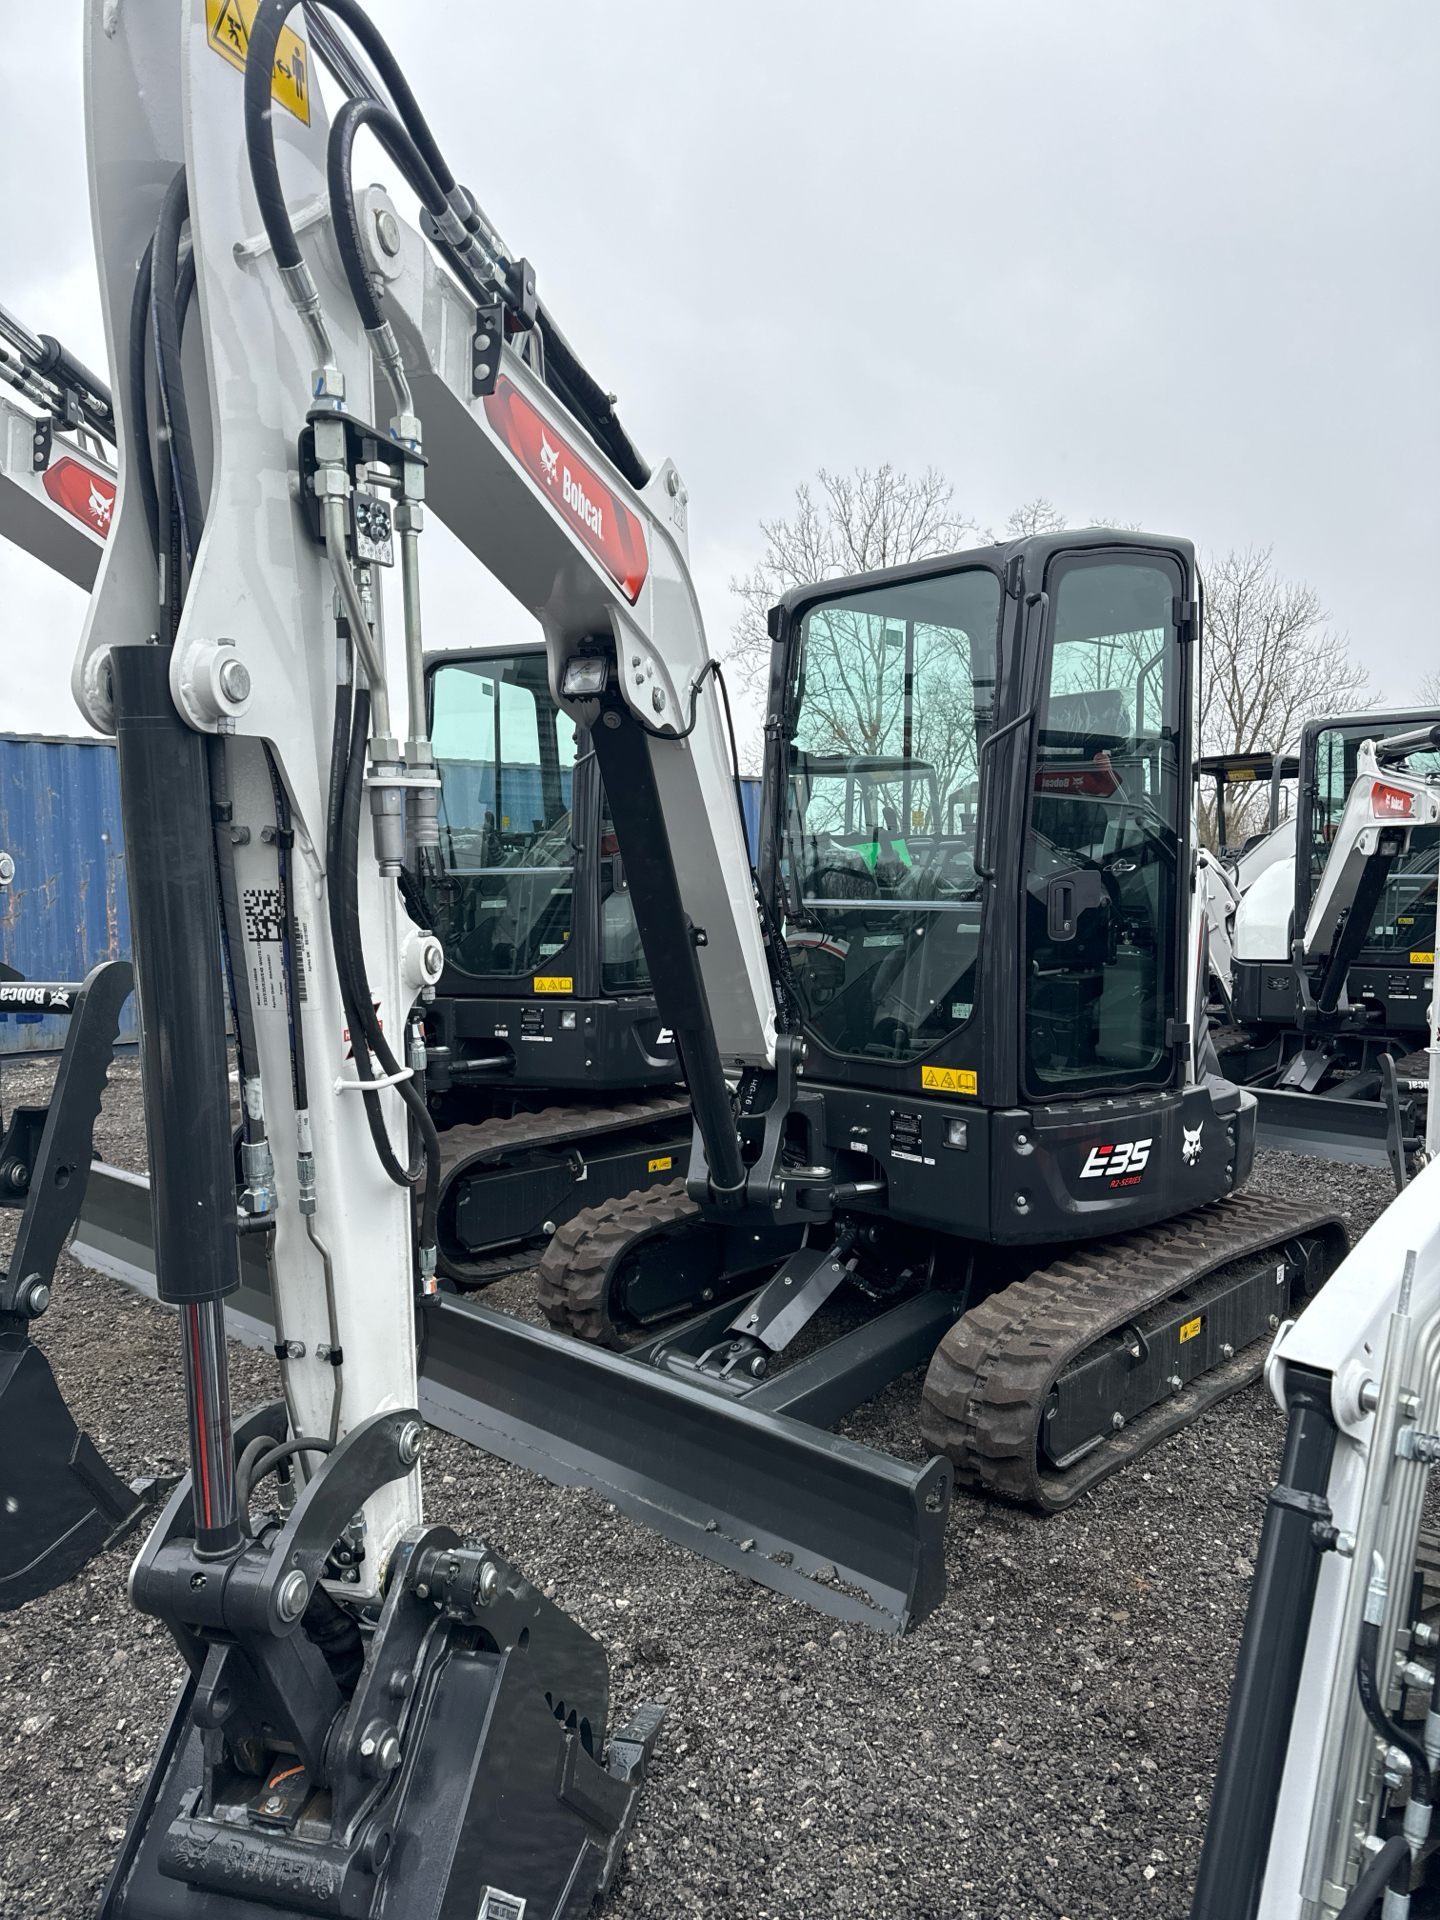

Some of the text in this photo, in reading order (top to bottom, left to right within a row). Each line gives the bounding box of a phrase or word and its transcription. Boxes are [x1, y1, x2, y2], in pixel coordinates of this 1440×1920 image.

[562, 465, 604, 540] Bobcat
[745, 1078, 758, 1105] HG-16
[1079, 1138, 1153, 1179] E35
[1110, 1176, 1142, 1188] R2-SERIES
